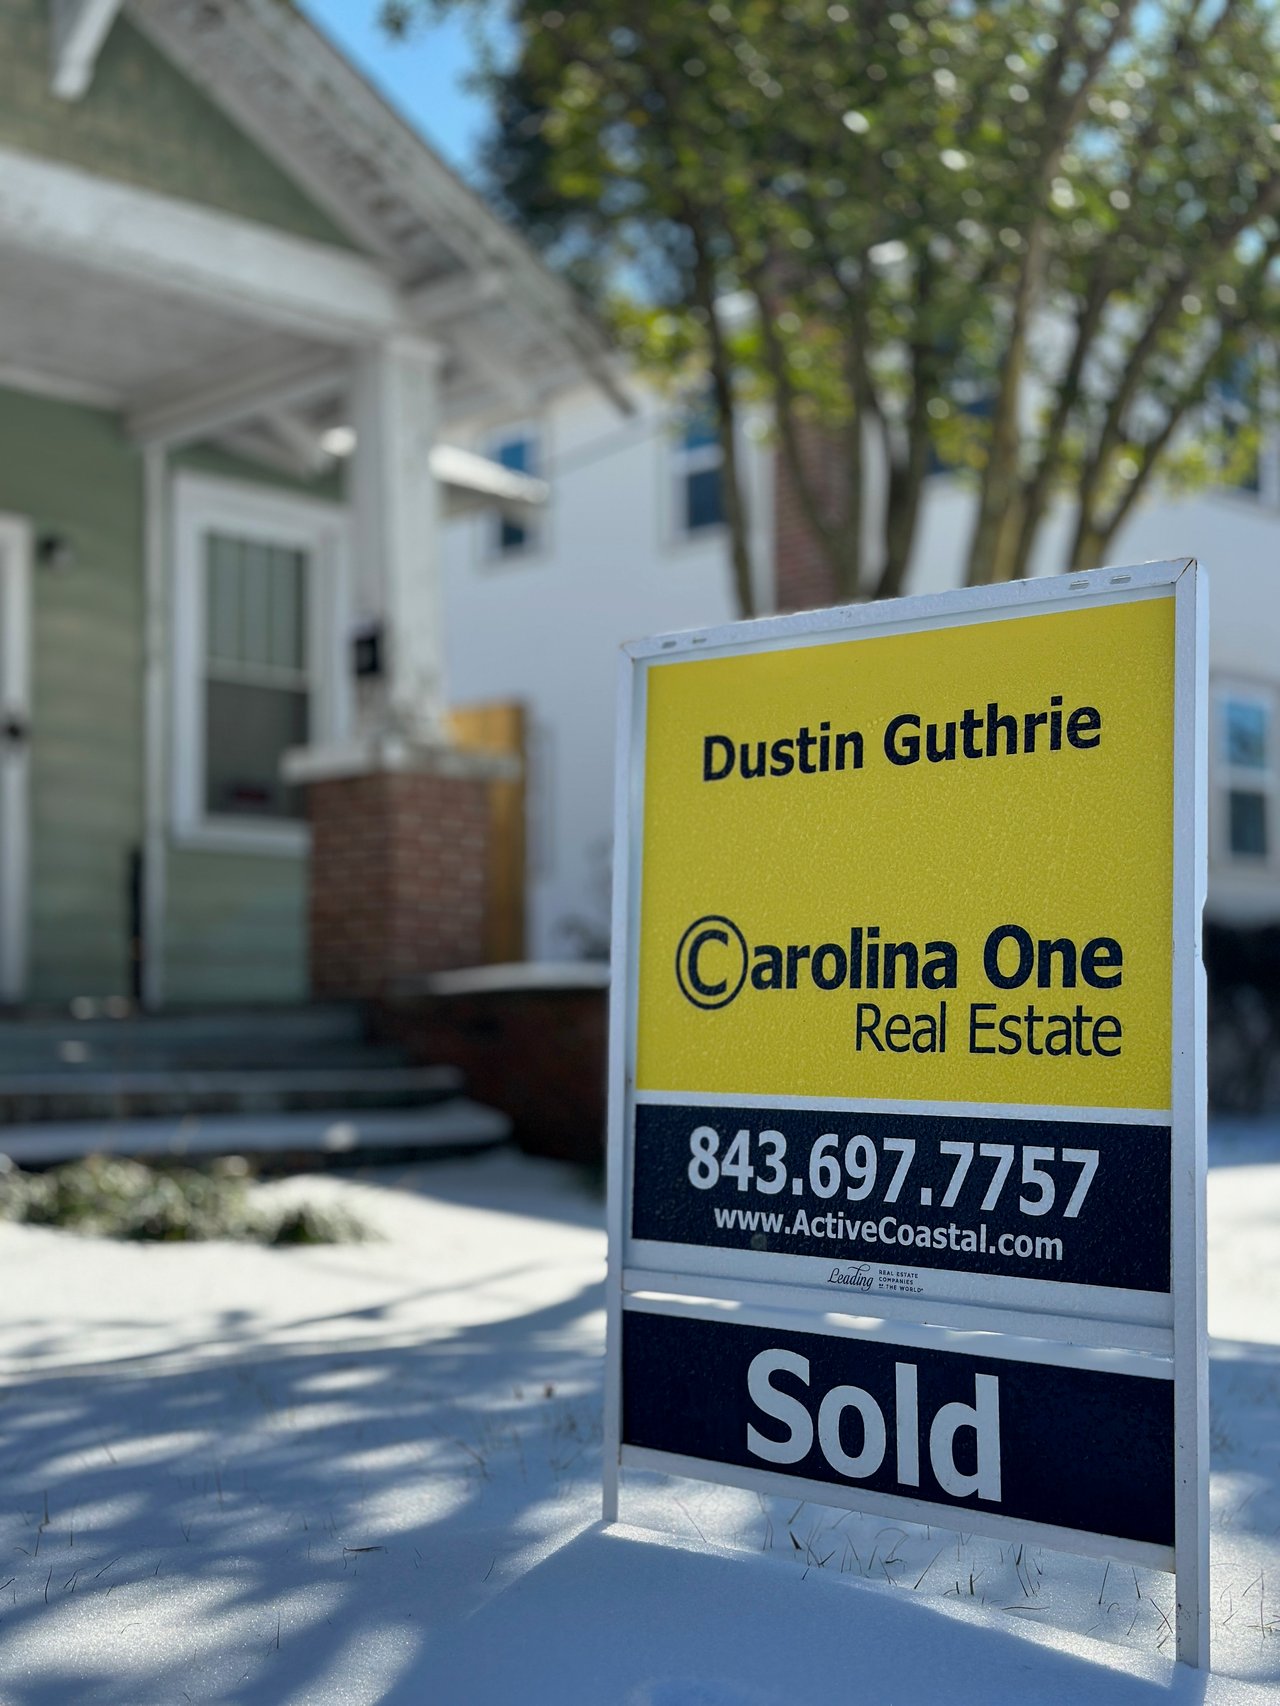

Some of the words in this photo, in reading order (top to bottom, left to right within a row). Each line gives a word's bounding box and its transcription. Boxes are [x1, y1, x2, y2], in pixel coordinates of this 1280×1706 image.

[703, 722, 863, 782] Dustin
[884, 696, 1102, 765] Guthrie
[676, 915, 958, 1010] Carolina
[984, 924, 1123, 989] One
[855, 1001, 947, 1053] Real
[969, 1003, 1122, 1056] Estate
[688, 1125, 1100, 1218] 843.697.7757
[714, 1206, 1064, 1261] www.ActiveCoastal.com
[827, 1264, 874, 1291] Leading
[878, 1277, 914, 1285] COMPANIES
[746, 1348, 1002, 1502] Sold
